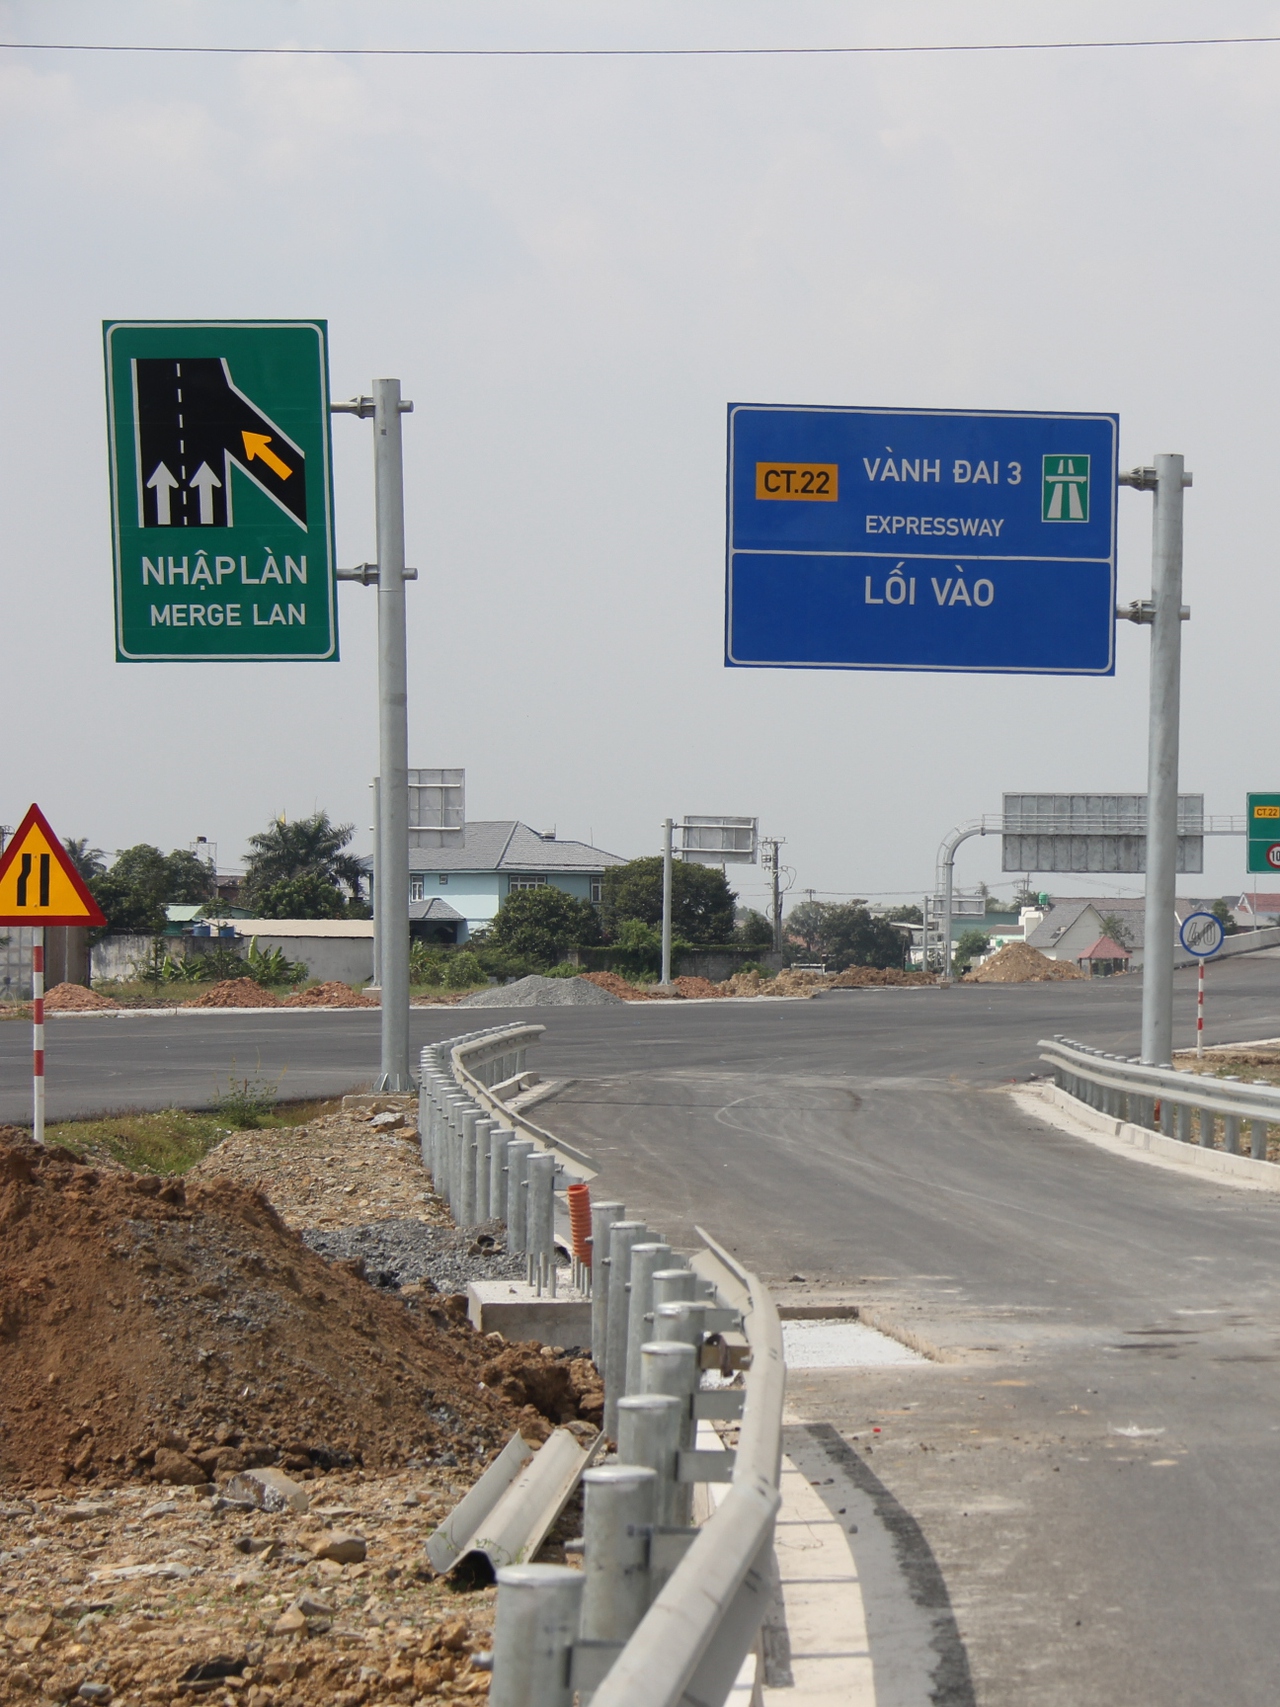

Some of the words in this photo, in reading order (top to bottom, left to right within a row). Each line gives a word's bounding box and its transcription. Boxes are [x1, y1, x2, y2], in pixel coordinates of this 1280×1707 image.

[862, 446, 941, 484] VÀNH
[952, 460, 999, 486] ĐAI
[1007, 461, 1022, 486] 3
[763, 469, 830, 495] CT.22
[865, 515, 1004, 538] EXPRESSWAY
[864, 562, 916, 605] LỐI
[931, 565, 994, 607] VÀO
[150, 603, 242, 627] MERGE
[253, 603, 306, 626] LAN
[1256, 808, 1278, 817] CT.22
[1187, 921, 1216, 946] 40
